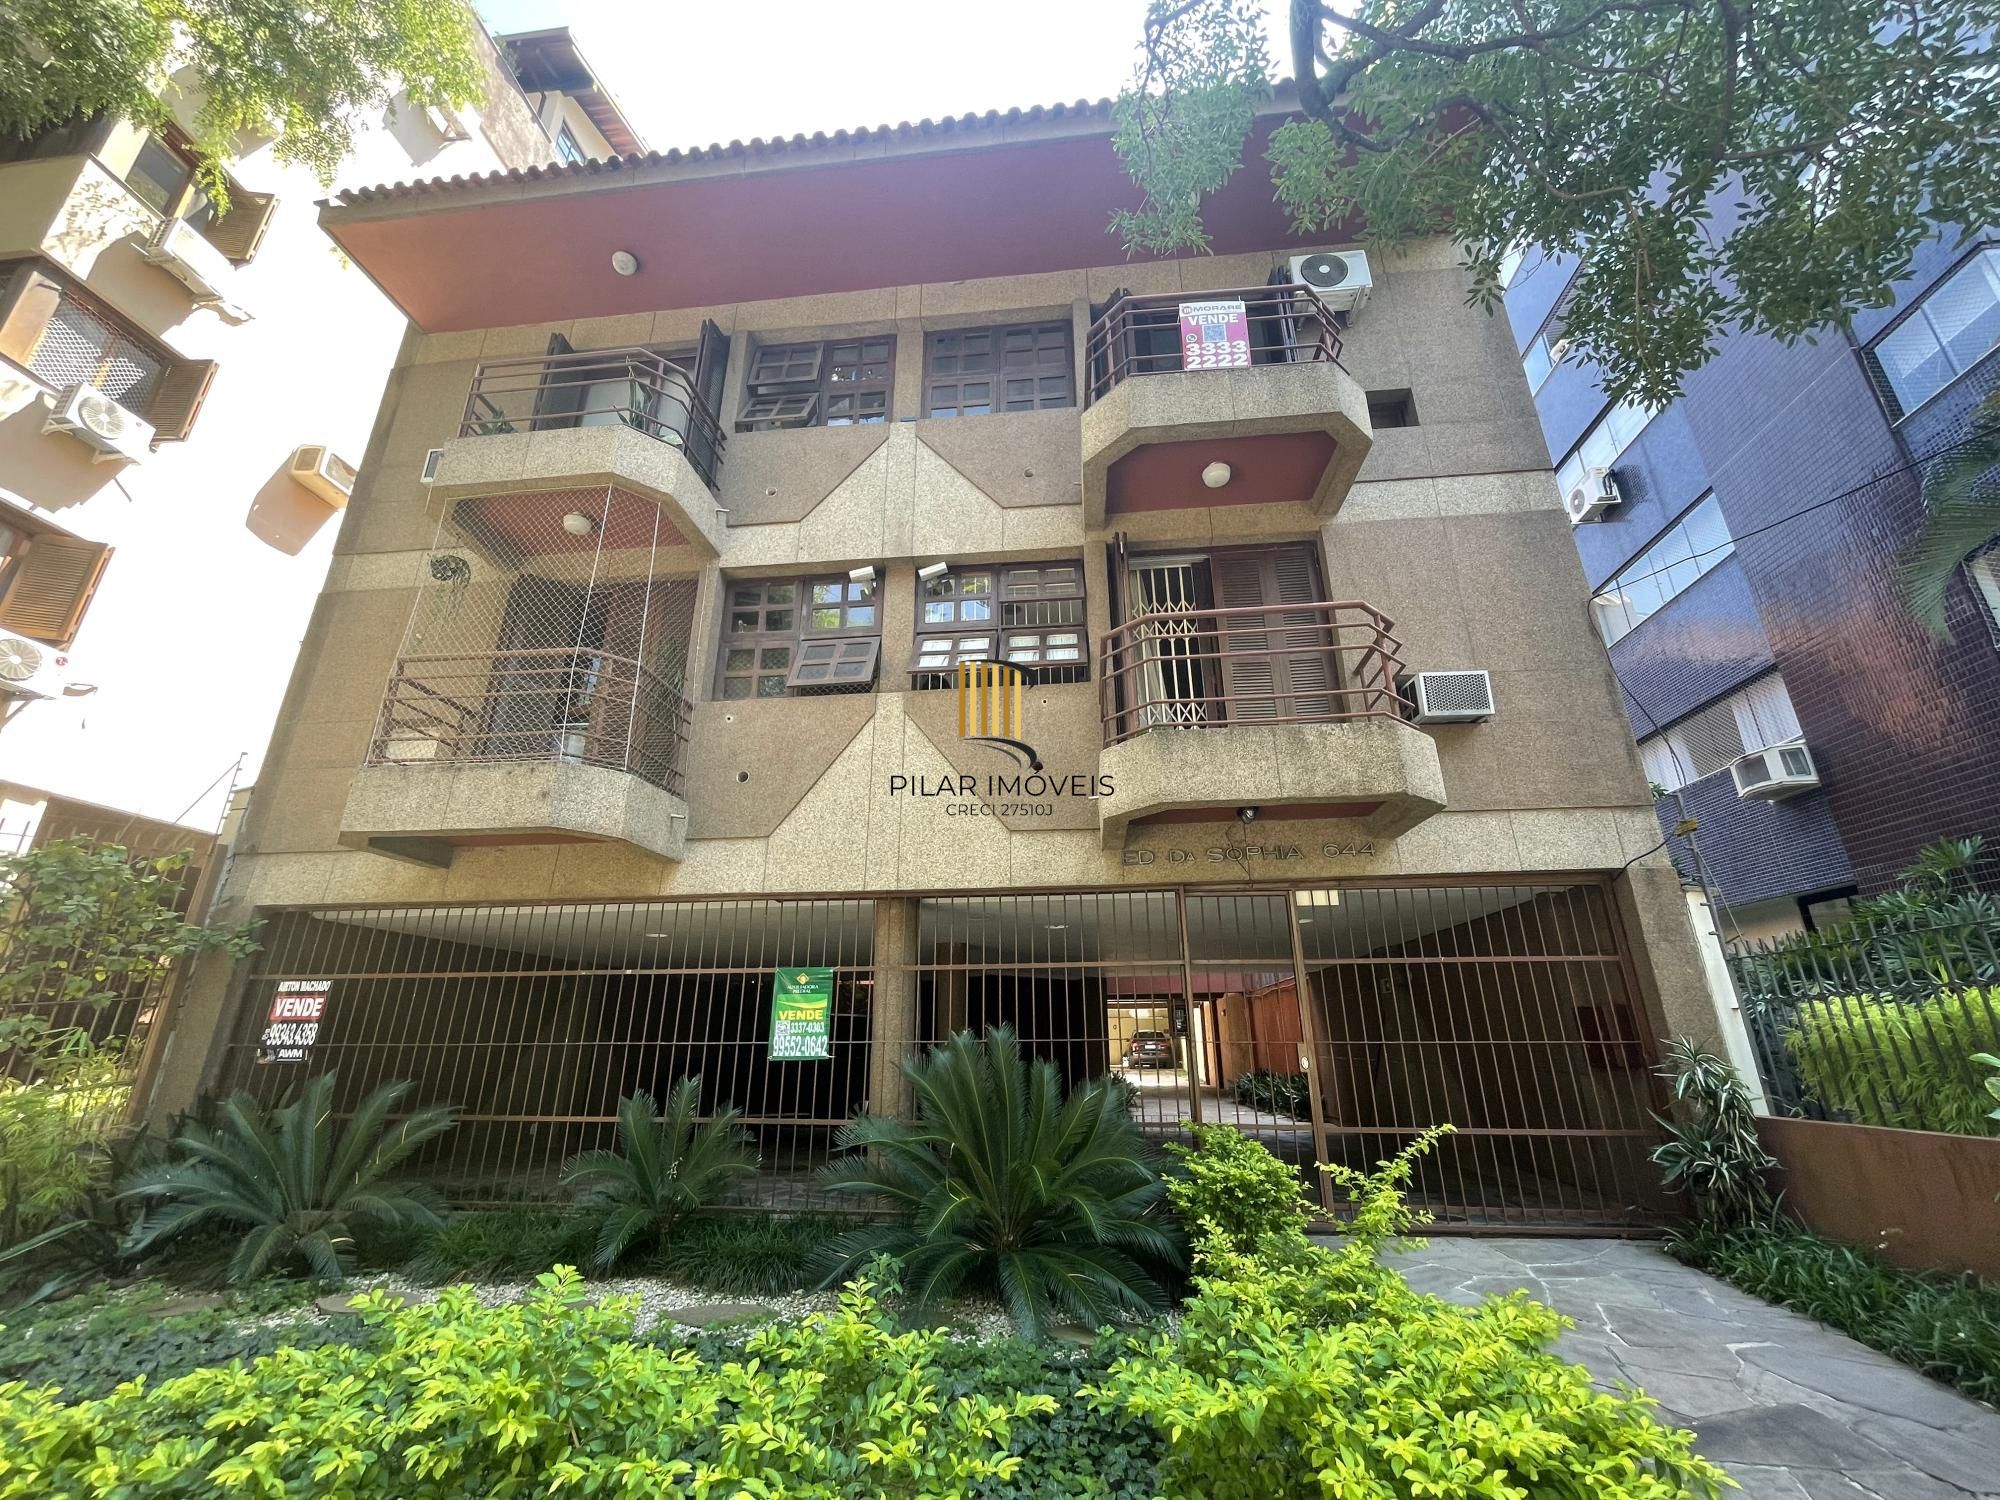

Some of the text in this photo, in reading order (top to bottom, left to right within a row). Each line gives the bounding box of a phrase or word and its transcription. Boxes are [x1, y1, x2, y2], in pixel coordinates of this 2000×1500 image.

[1188, 314, 1239, 326] VENDE
[1185, 340, 1247, 356] 3333
[1186, 353, 1249, 369] 2222
[1121, 850, 1154, 866] ED
[1206, 845, 1304, 863] SOPHIA
[1322, 841, 1376, 858] 644
[275, 998, 324, 1016] VENDE
[779, 1010, 823, 1020] VENDE
[790, 1022, 824, 1033] 3337-0303
[278, 1049, 303, 1057] AWM
[773, 1035, 828, 1056] 99552-0642
